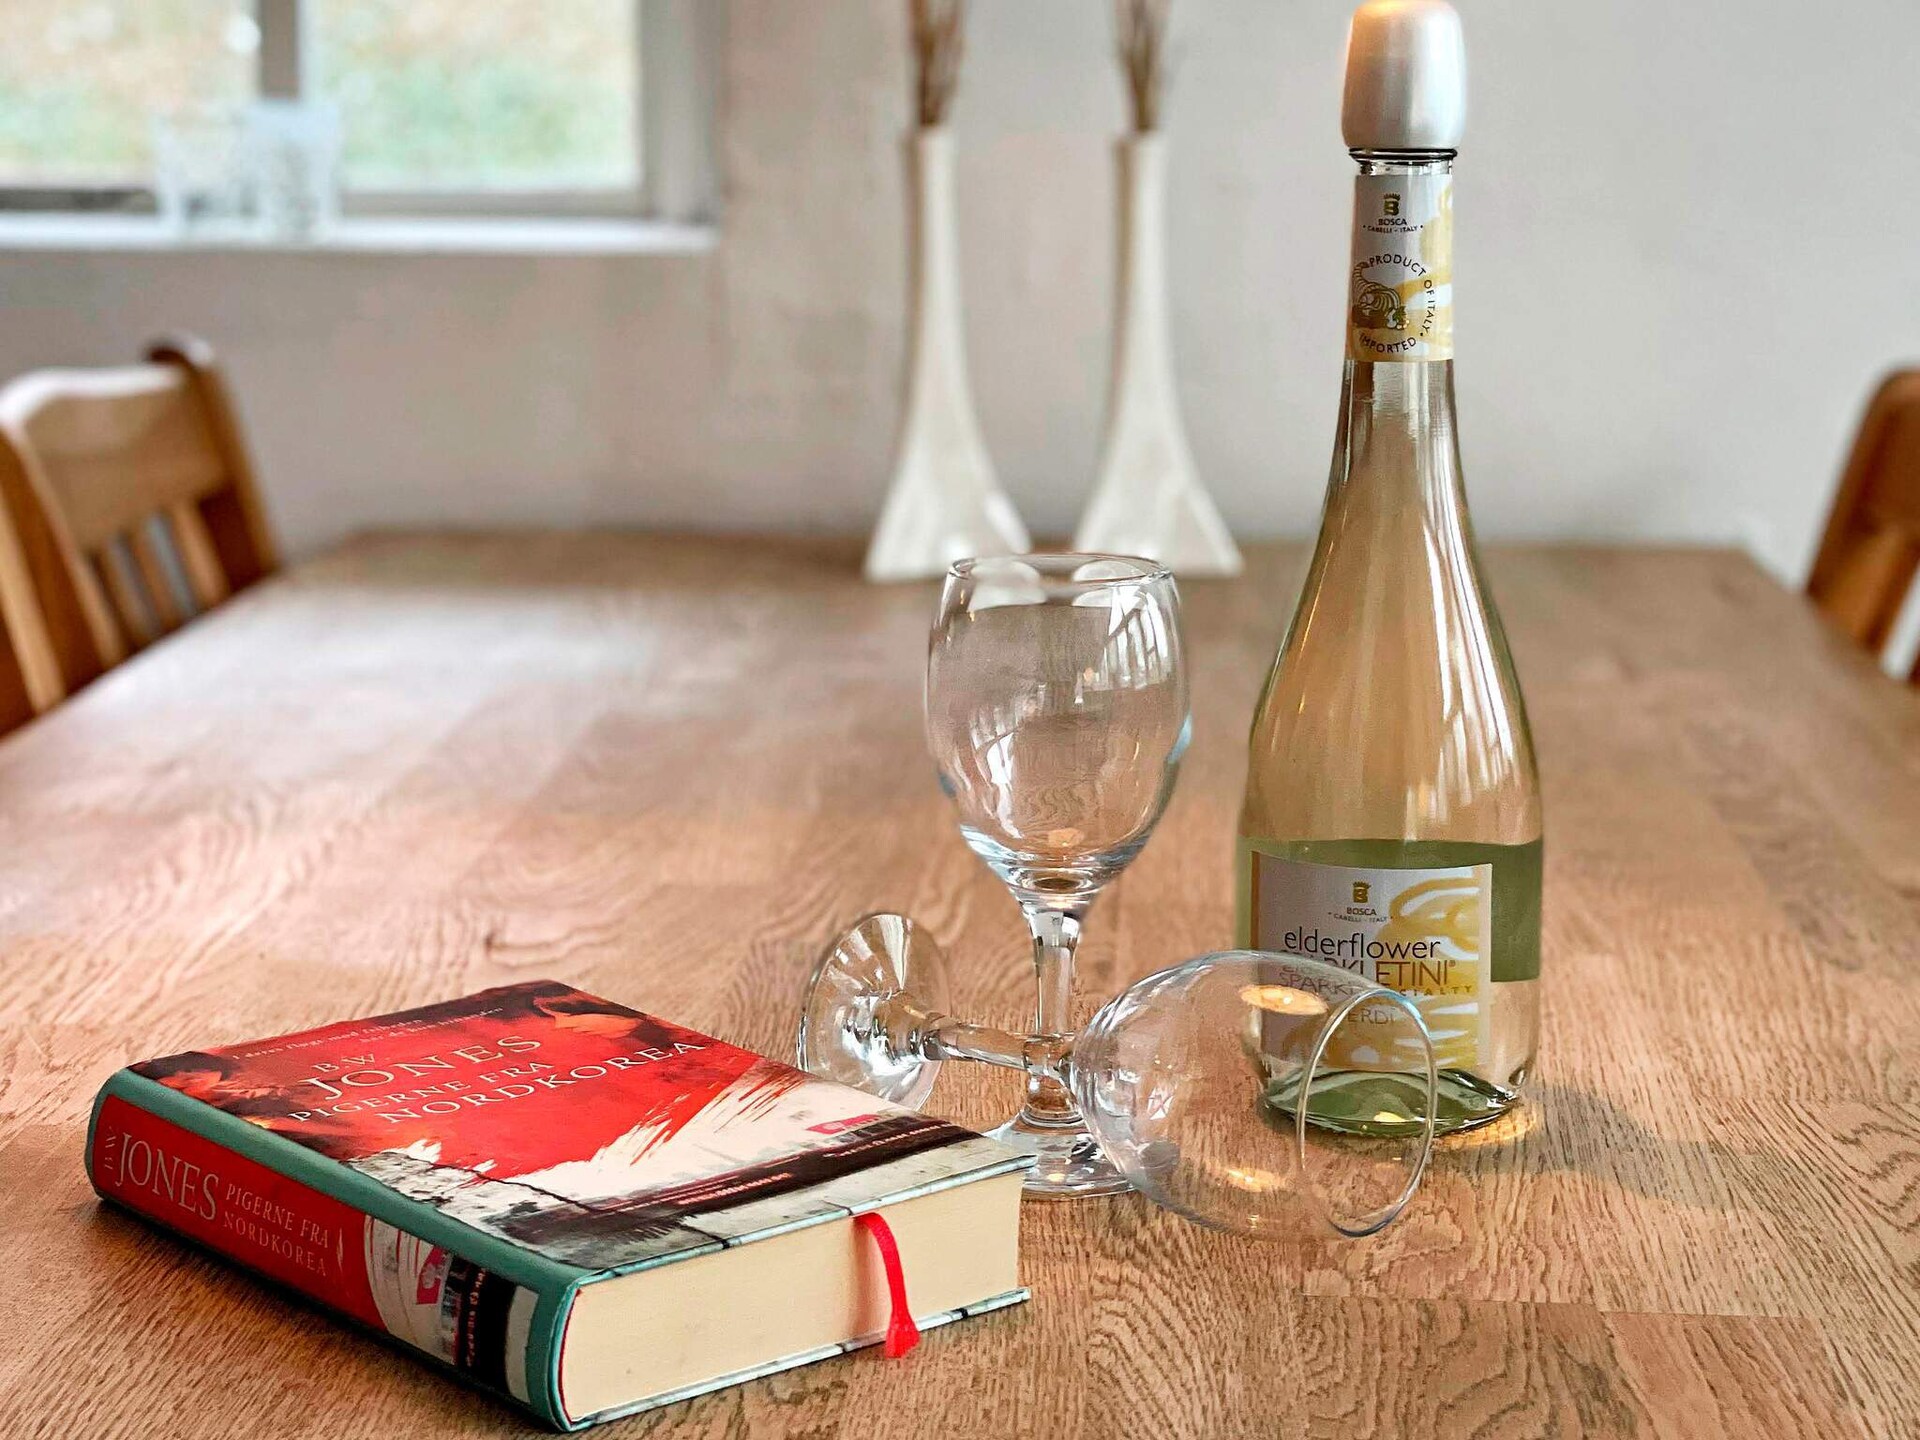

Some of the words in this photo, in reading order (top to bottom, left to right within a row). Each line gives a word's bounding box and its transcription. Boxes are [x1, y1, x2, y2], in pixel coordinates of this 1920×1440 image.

[1378, 218, 1407, 226] BOSCA
[1368, 253, 1426, 277] PRODUCT
[1423, 279, 1435, 296] OF
[1421, 300, 1436, 334] ITALY
[1358, 332, 1417, 354] IMPORTED
[1346, 907, 1377, 916] BOSCA
[1284, 926, 1441, 959] elderflower
[298, 1035, 541, 1100] JONES
[375, 1041, 706, 1124] NORDKOREA
[288, 1080, 471, 1123] PIGERNE
[479, 1060, 555, 1083] FRA
[115, 1132, 219, 1220] JONES
[226, 1183, 295, 1231] PIGERNE
[300, 1218, 328, 1249] FRA
[223, 1211, 326, 1277] NORDKOREA
